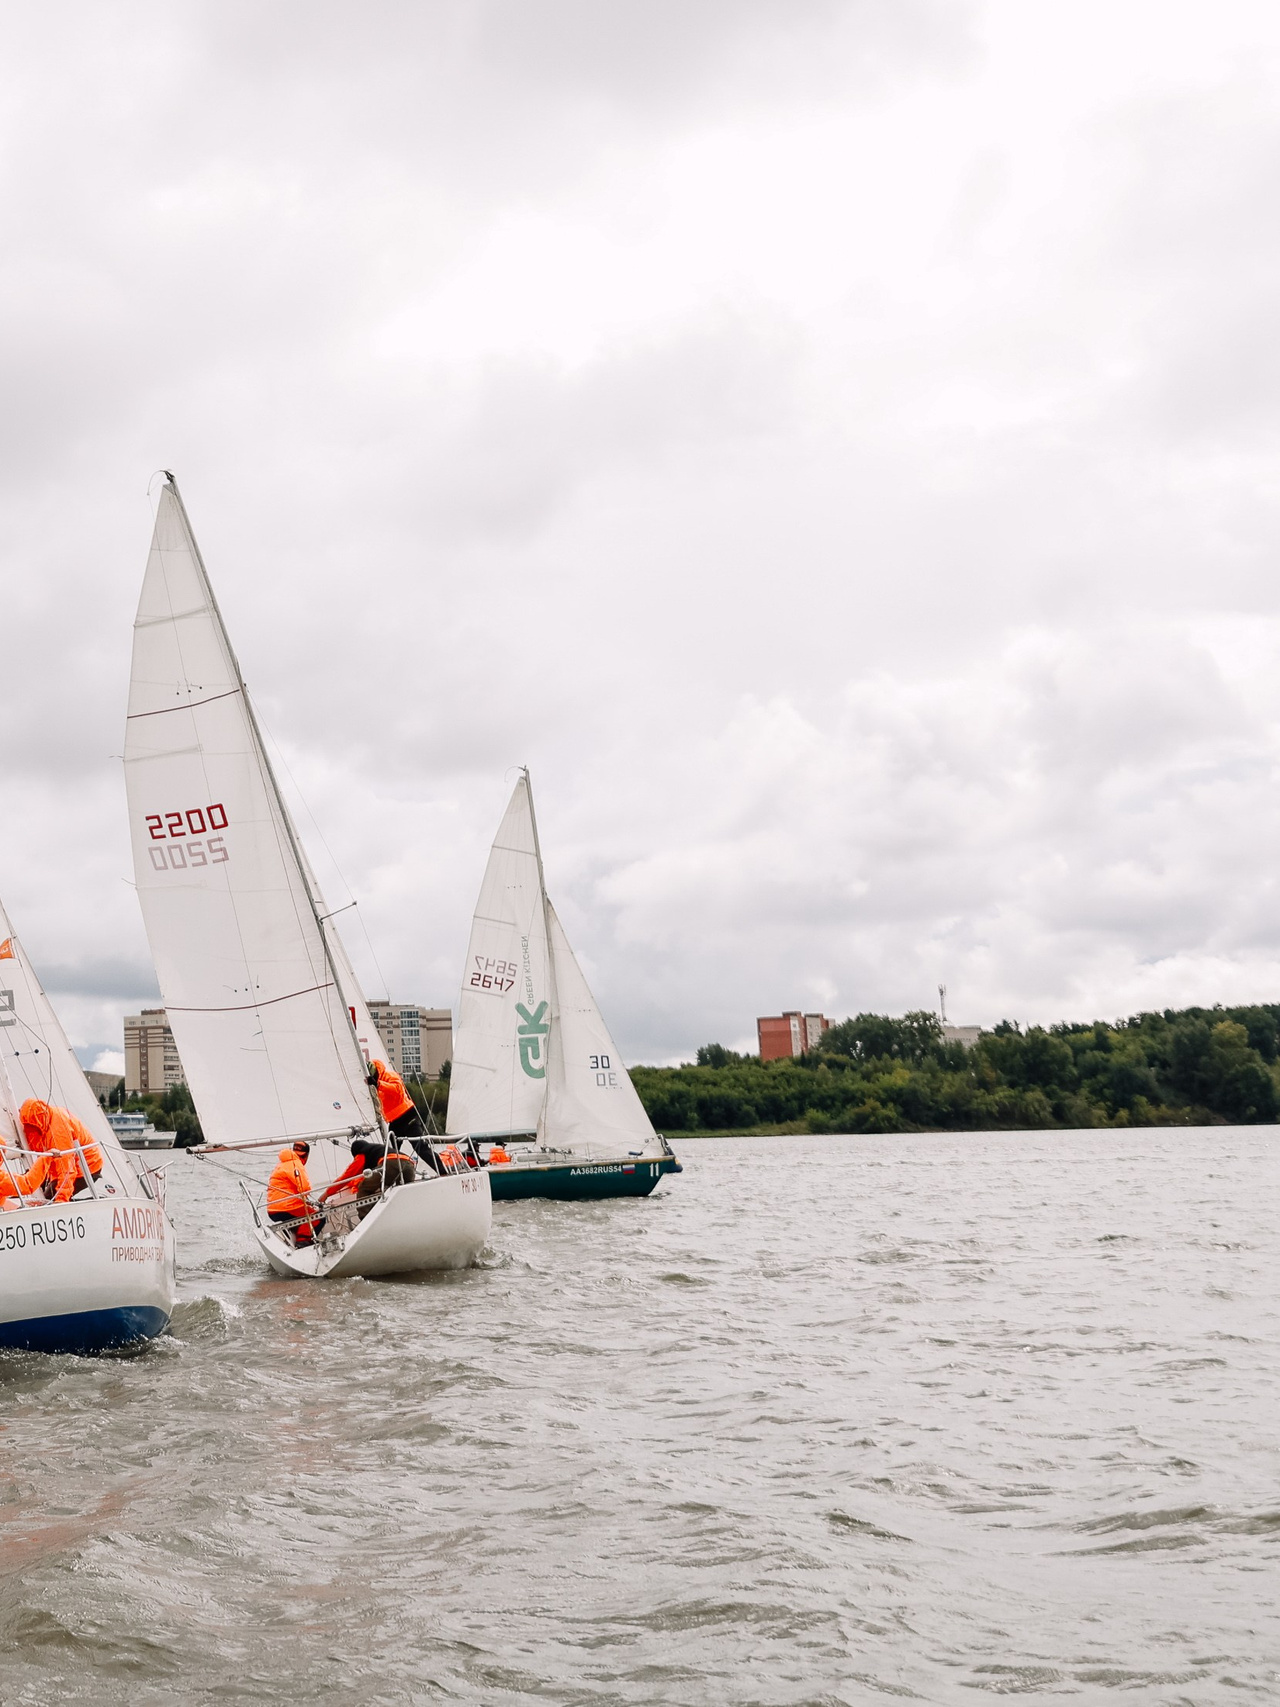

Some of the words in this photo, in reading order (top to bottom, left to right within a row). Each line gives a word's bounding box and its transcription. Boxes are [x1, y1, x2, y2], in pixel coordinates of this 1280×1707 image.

[145, 803, 229, 839] 2200
[470, 972, 515, 992] 2647
[589, 1055, 610, 1069] 30
[649, 1162, 660, 1177] 11
[30, 1216, 86, 1246] RUS16
